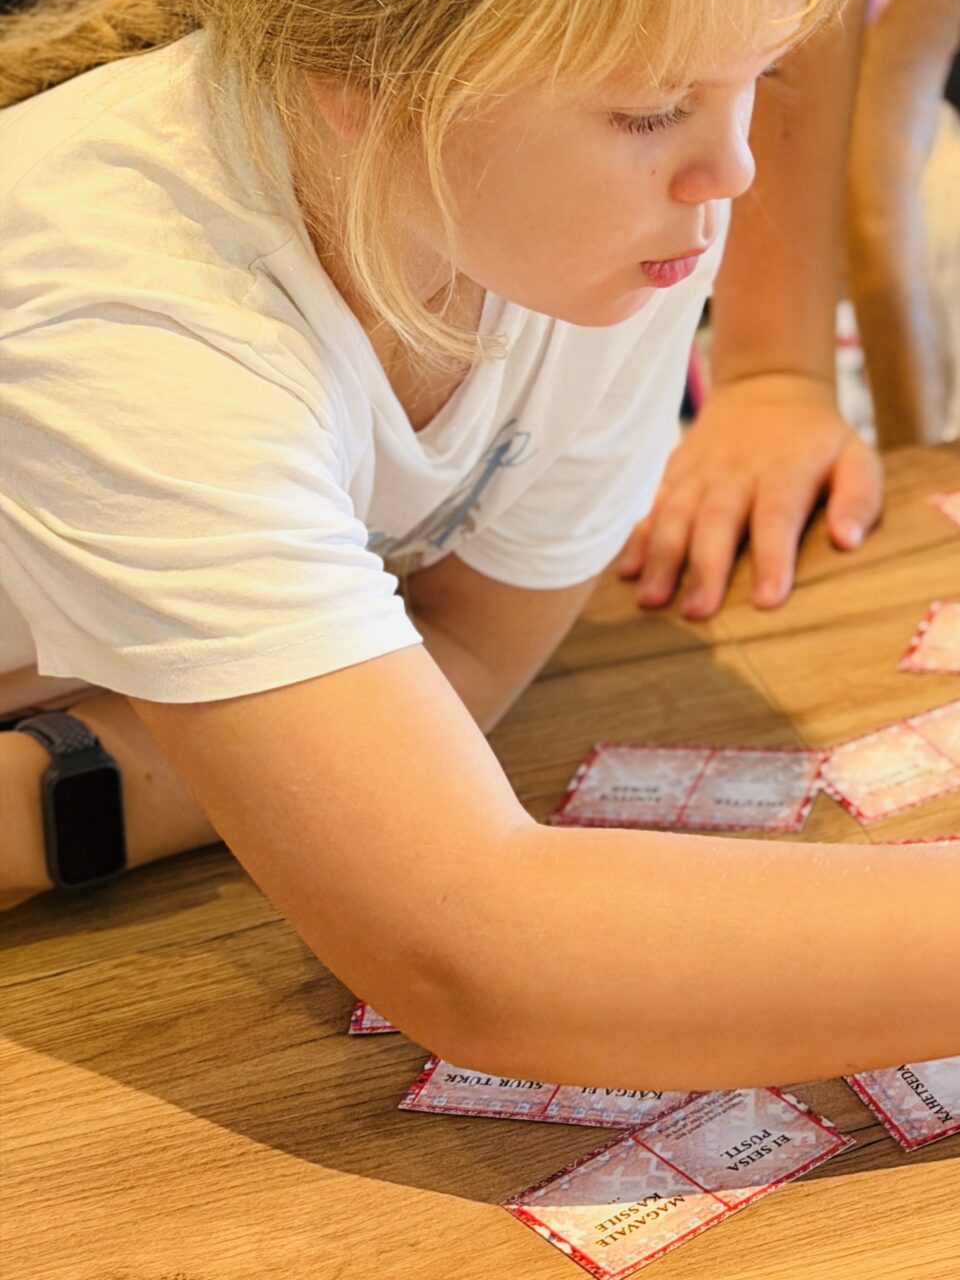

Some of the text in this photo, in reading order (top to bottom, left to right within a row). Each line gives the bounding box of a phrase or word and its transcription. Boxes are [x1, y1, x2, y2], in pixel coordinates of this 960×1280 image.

[719, 1129, 773, 1159] PÜSTI.
[725, 1134, 792, 1172] EI SEISA
[594, 1192, 664, 1232] KASSILE
[595, 1194, 687, 1248] MAGAVALE
